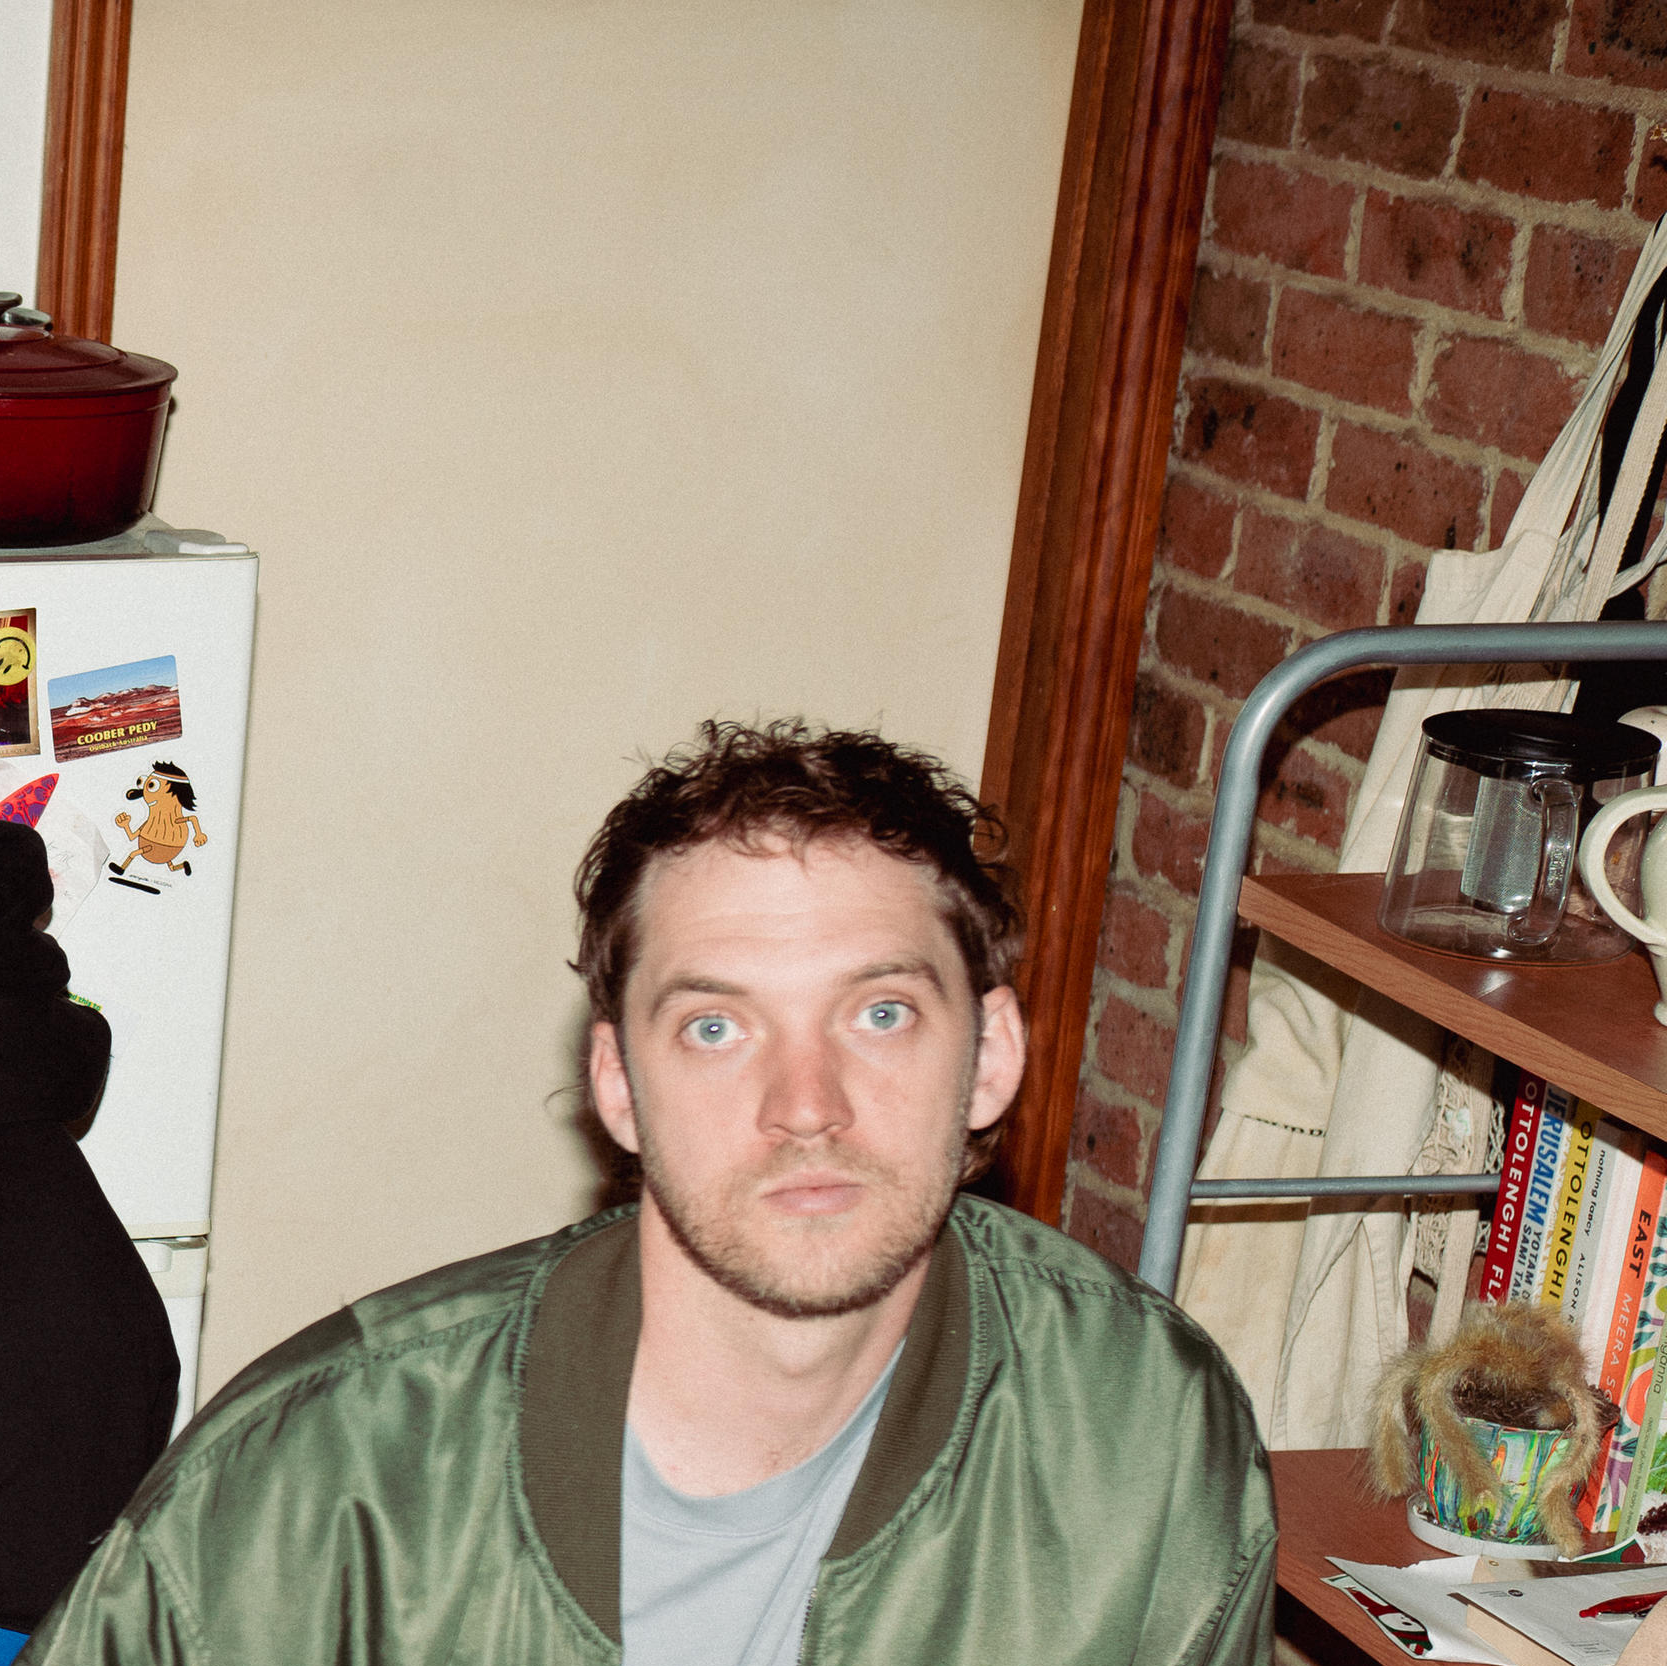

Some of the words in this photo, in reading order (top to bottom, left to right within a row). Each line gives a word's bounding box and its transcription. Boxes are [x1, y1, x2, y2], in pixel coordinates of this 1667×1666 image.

[77, 727, 125, 746] COOBER
[128, 721, 158, 736] PEDY
[1496, 1081, 1538, 1254] OTTOLENGHI
[1528, 1088, 1565, 1227] JERUSALEM
[1590, 1149, 1606, 1198] nothing
[1549, 1121, 1593, 1301] OTTOLENGHI
[1584, 1199, 1597, 1237] fancy
[1518, 1224, 1532, 1267] SAMI
[1527, 1231, 1543, 1282] YOTAM
[1628, 1209, 1652, 1280] EAST
[1570, 1252, 1586, 1311] ALISON
[1610, 1292, 1634, 1367] MEERA
